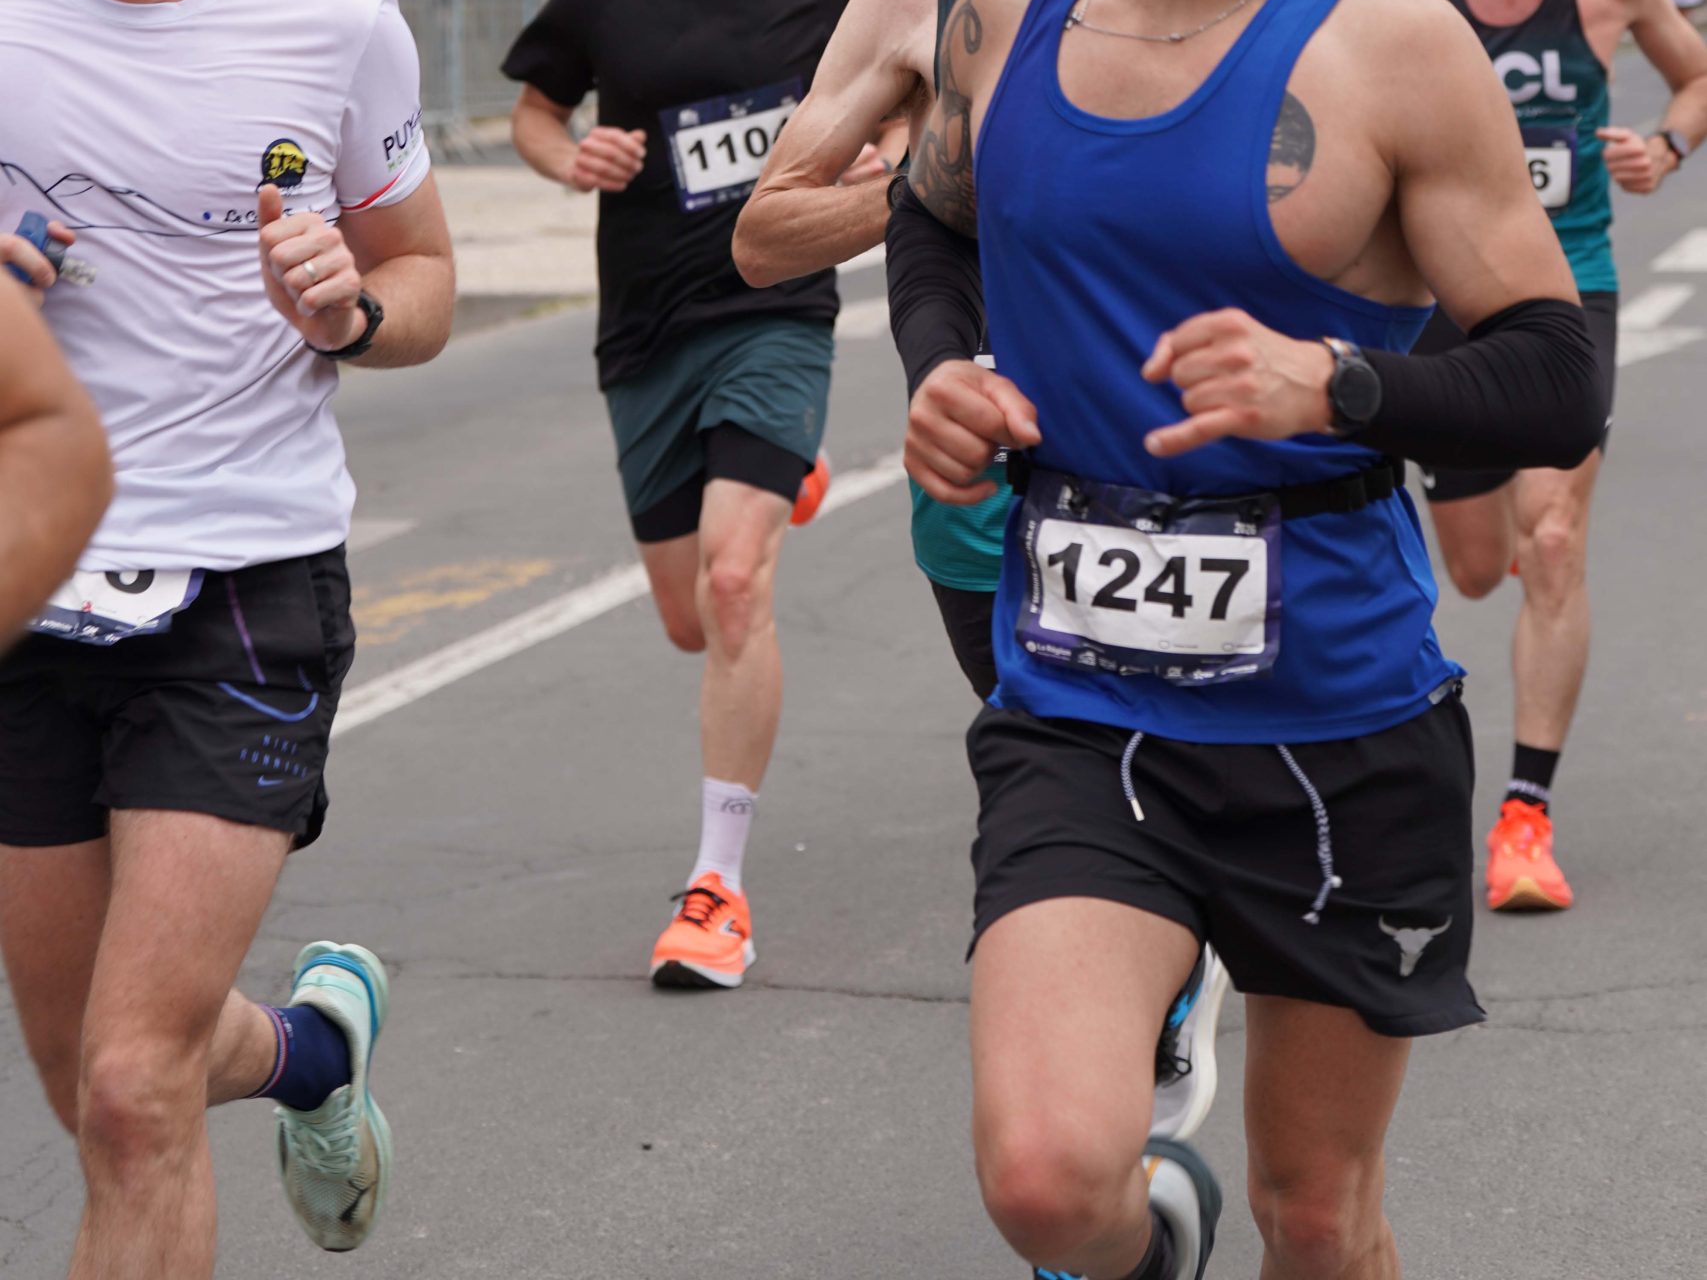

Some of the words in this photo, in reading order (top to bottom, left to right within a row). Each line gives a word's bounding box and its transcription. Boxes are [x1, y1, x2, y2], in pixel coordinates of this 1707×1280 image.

[1492, 49, 1577, 104] CL
[687, 117, 788, 170] 110
[1047, 541, 1250, 621] 1247
